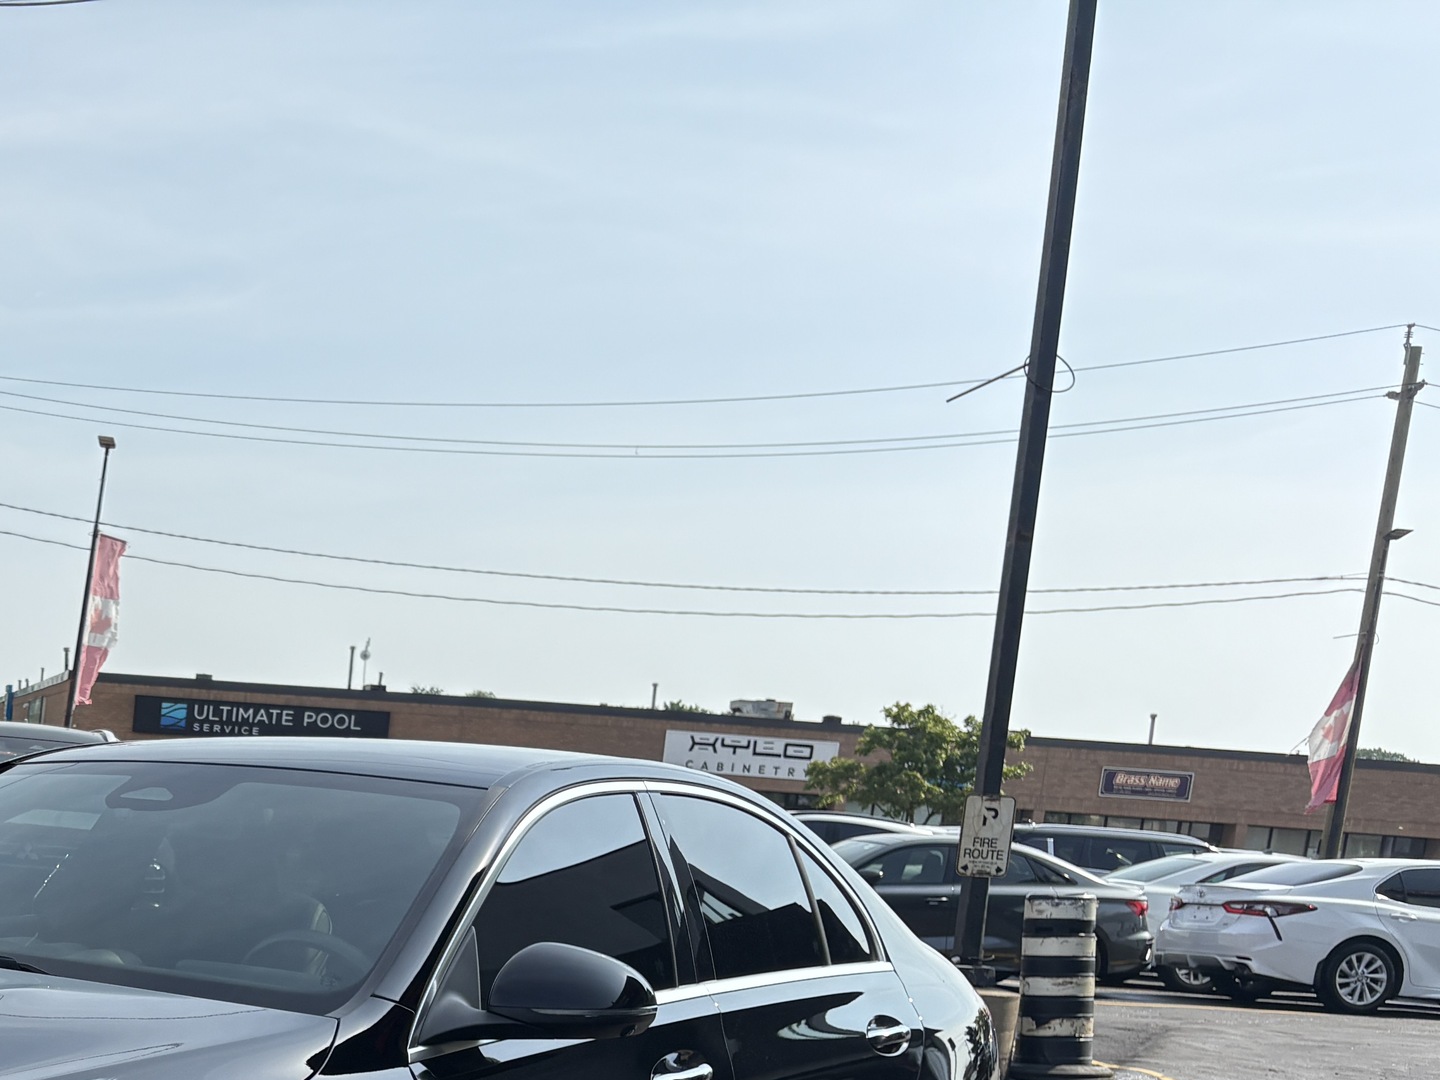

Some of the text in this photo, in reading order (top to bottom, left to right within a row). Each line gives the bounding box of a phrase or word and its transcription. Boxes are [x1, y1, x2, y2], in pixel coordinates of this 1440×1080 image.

[193, 704, 362, 731] ULTIMATE POOL
[192, 723, 260, 736] SERVICE
[688, 735, 814, 760] XYLO
[972, 836, 998, 849] FIRE
[963, 847, 1005, 861] ROUTE
